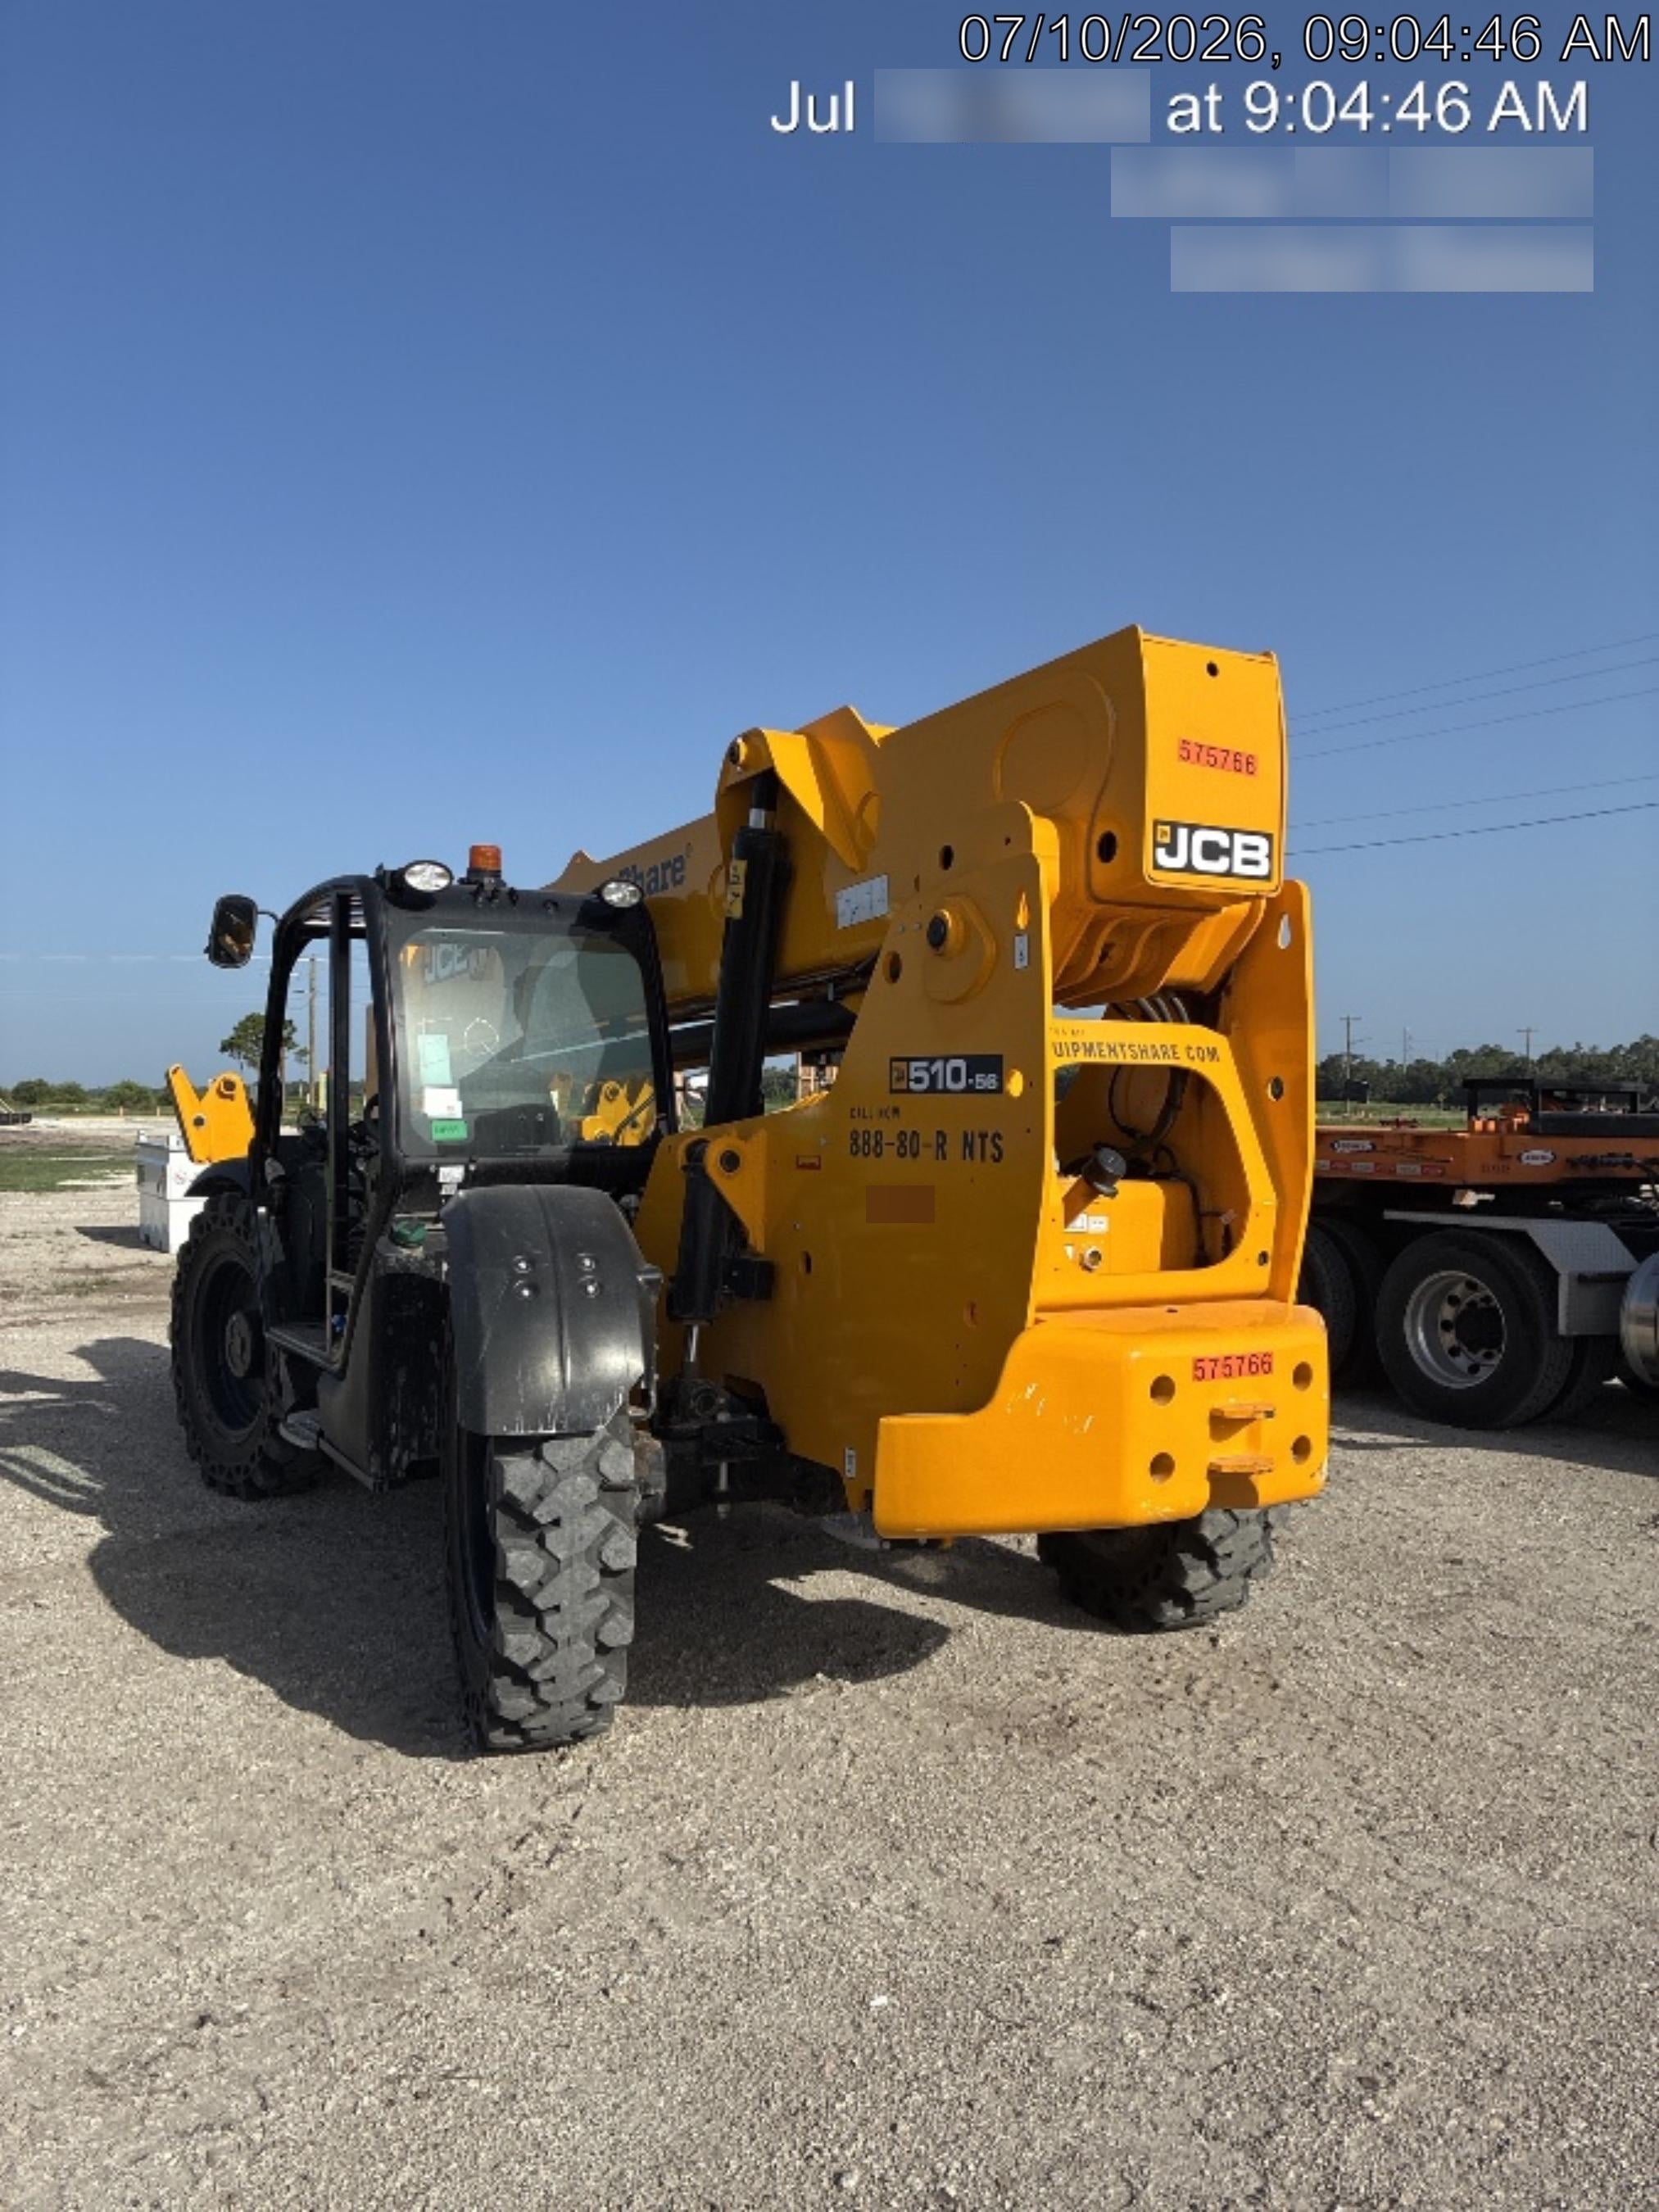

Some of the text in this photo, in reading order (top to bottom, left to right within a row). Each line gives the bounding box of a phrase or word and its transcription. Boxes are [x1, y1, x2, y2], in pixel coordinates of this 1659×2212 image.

[1179, 739, 1256, 775] 575766
[1155, 827, 1270, 877] JCB
[1194, 1353, 1271, 1381] 575766
